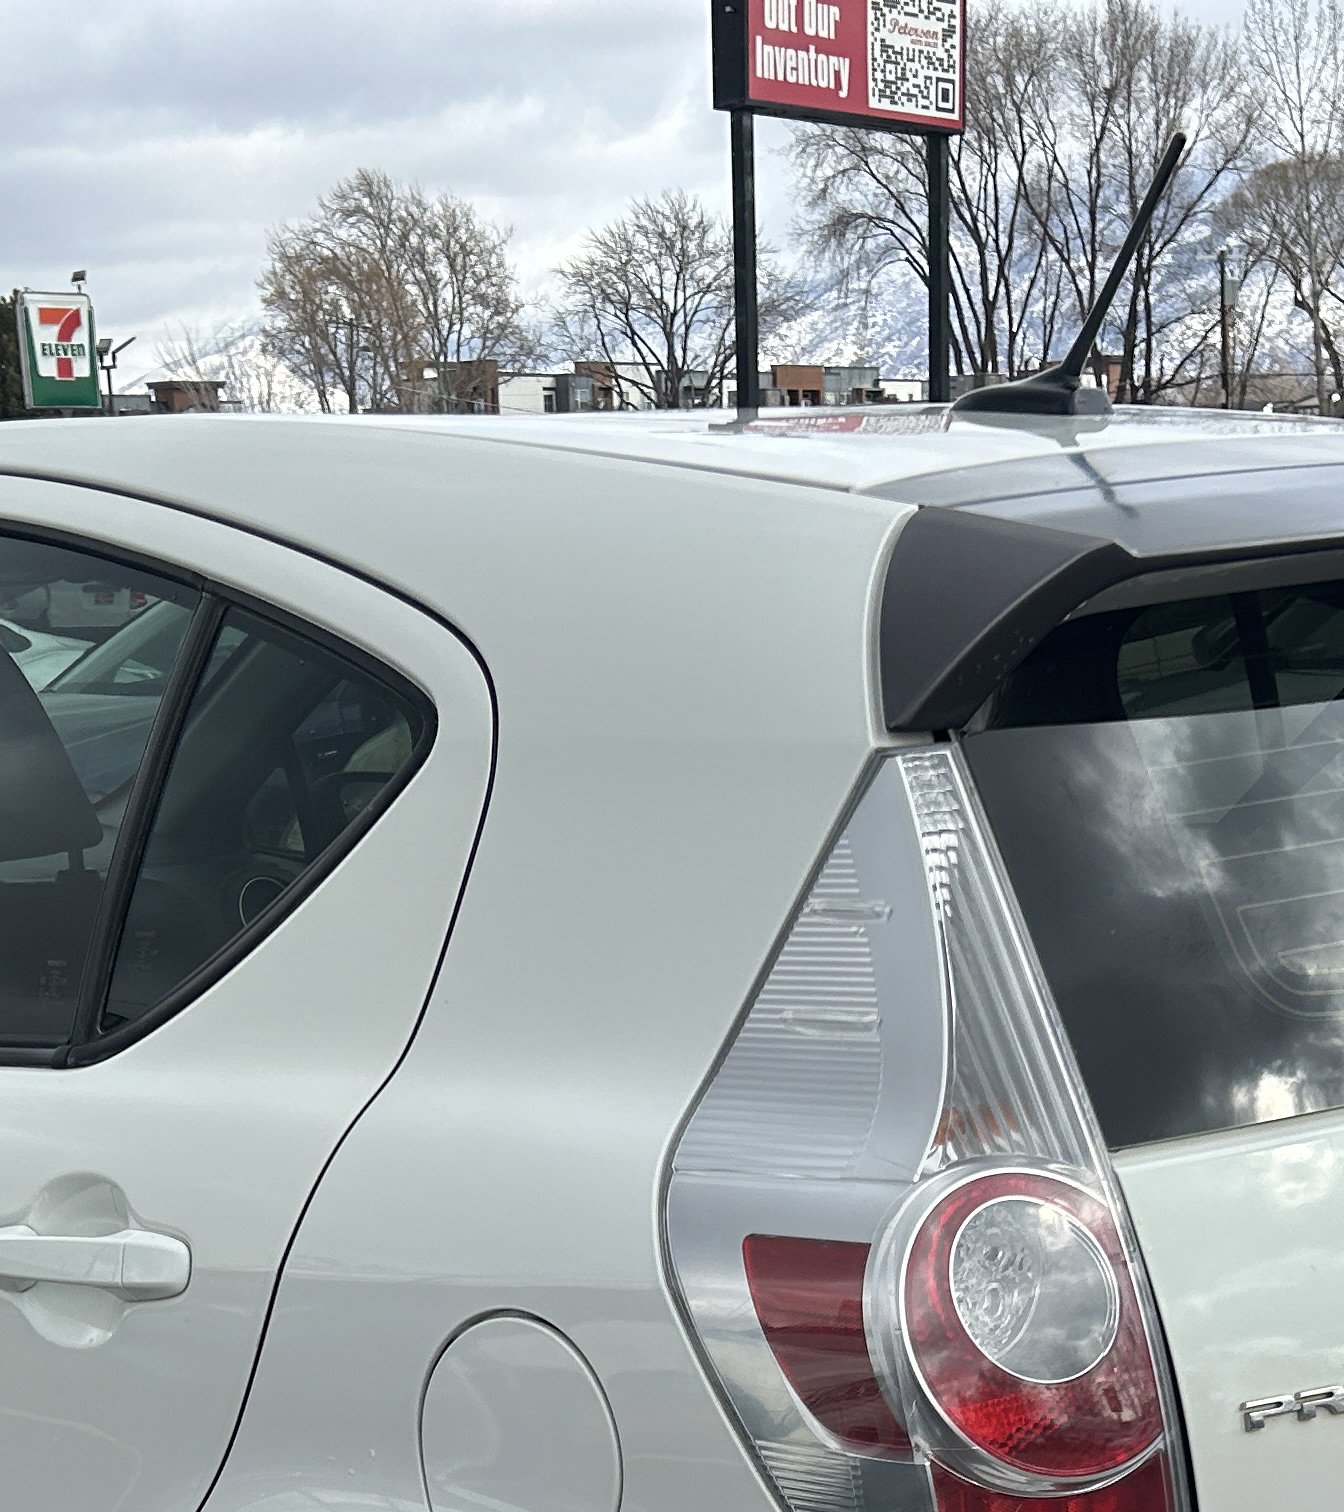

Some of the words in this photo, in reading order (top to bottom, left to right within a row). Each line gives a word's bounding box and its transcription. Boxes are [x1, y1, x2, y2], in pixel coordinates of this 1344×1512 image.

[804, 0, 840, 40] Our
[755, 35, 850, 98] Inventory
[39, 308, 81, 379] 7
